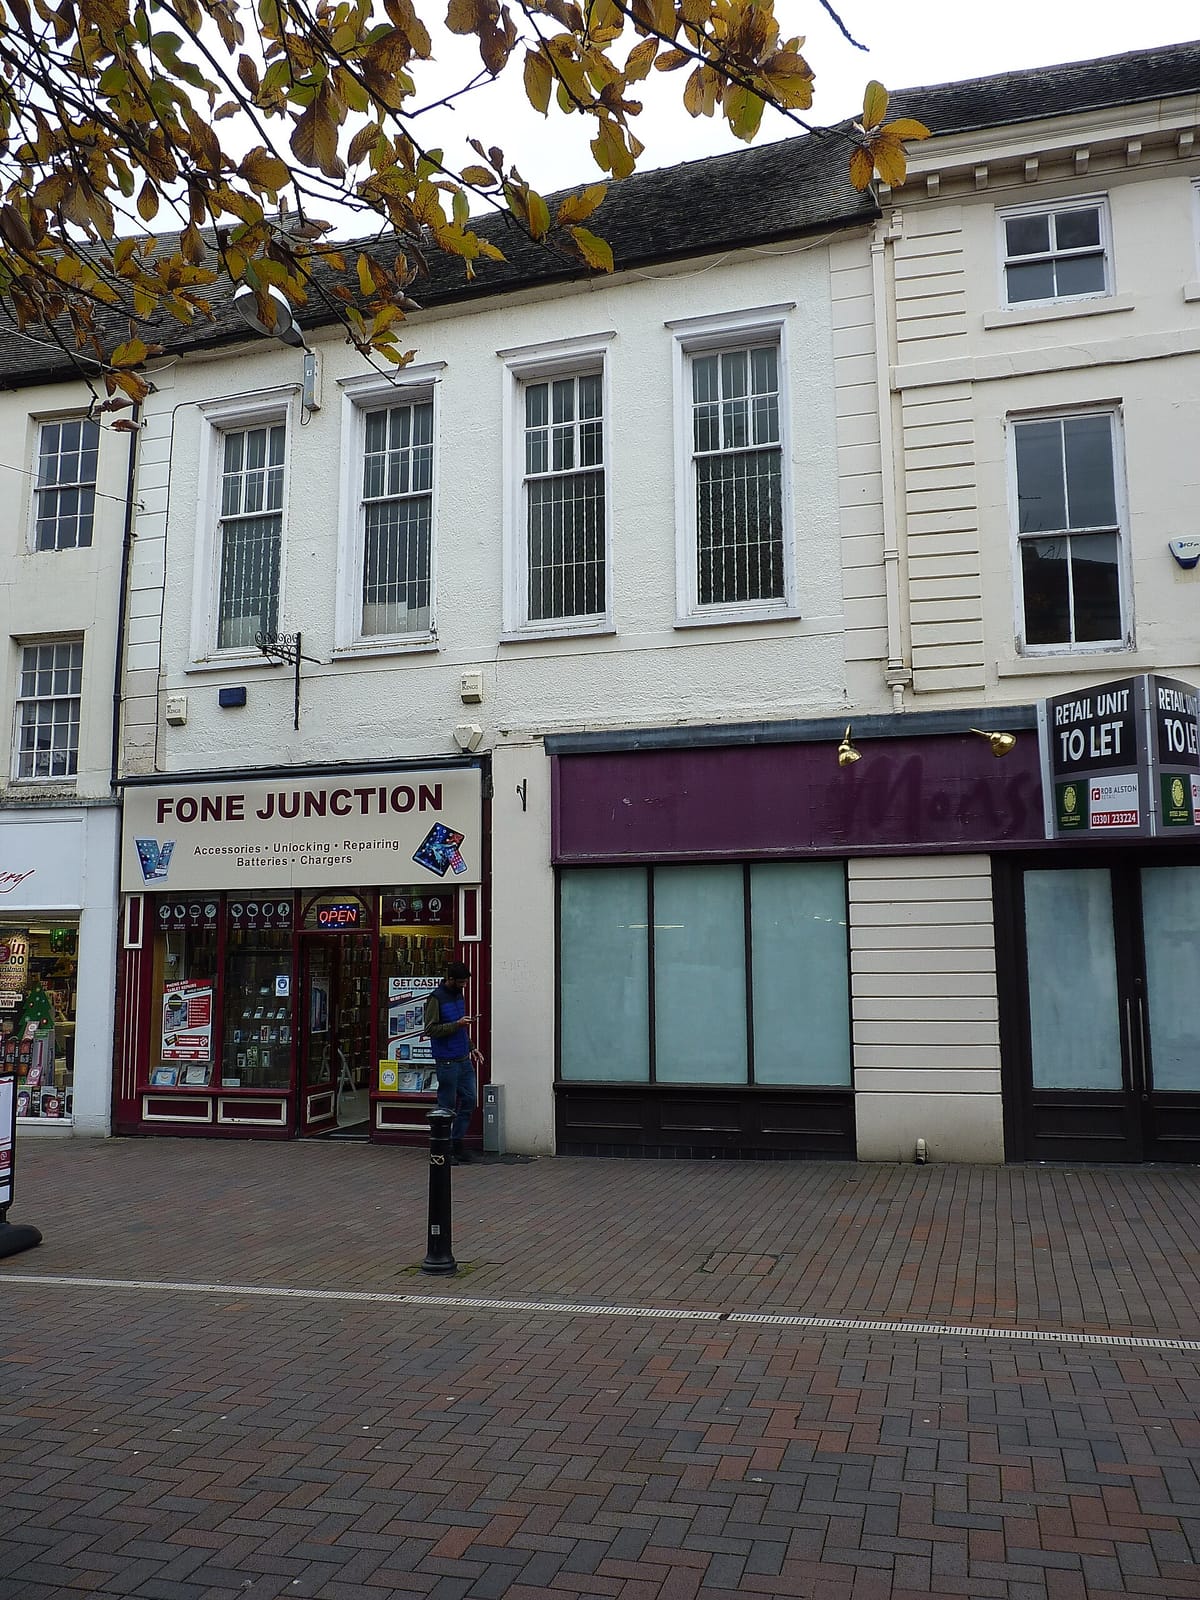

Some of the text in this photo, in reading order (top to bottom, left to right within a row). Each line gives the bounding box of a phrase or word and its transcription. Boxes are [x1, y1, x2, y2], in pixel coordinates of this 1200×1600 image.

[1055, 689, 1130, 726] RETAIL UNIT
[1158, 687, 1186, 714] RETAIL
[1060, 721, 1124, 762] TO LET
[1164, 718, 1185, 753] TO
[1114, 785, 1137, 793] ALSTON
[157, 783, 443, 824] FONE JUNCTION
[1093, 812, 1136, 824] 03301 233224
[193, 838, 399, 856] Accessories Unlocking Repairing
[236, 854, 352, 867] Batteries Chargers
[319, 910, 357, 922] OPEN
[393, 978, 440, 987] GET CASH
